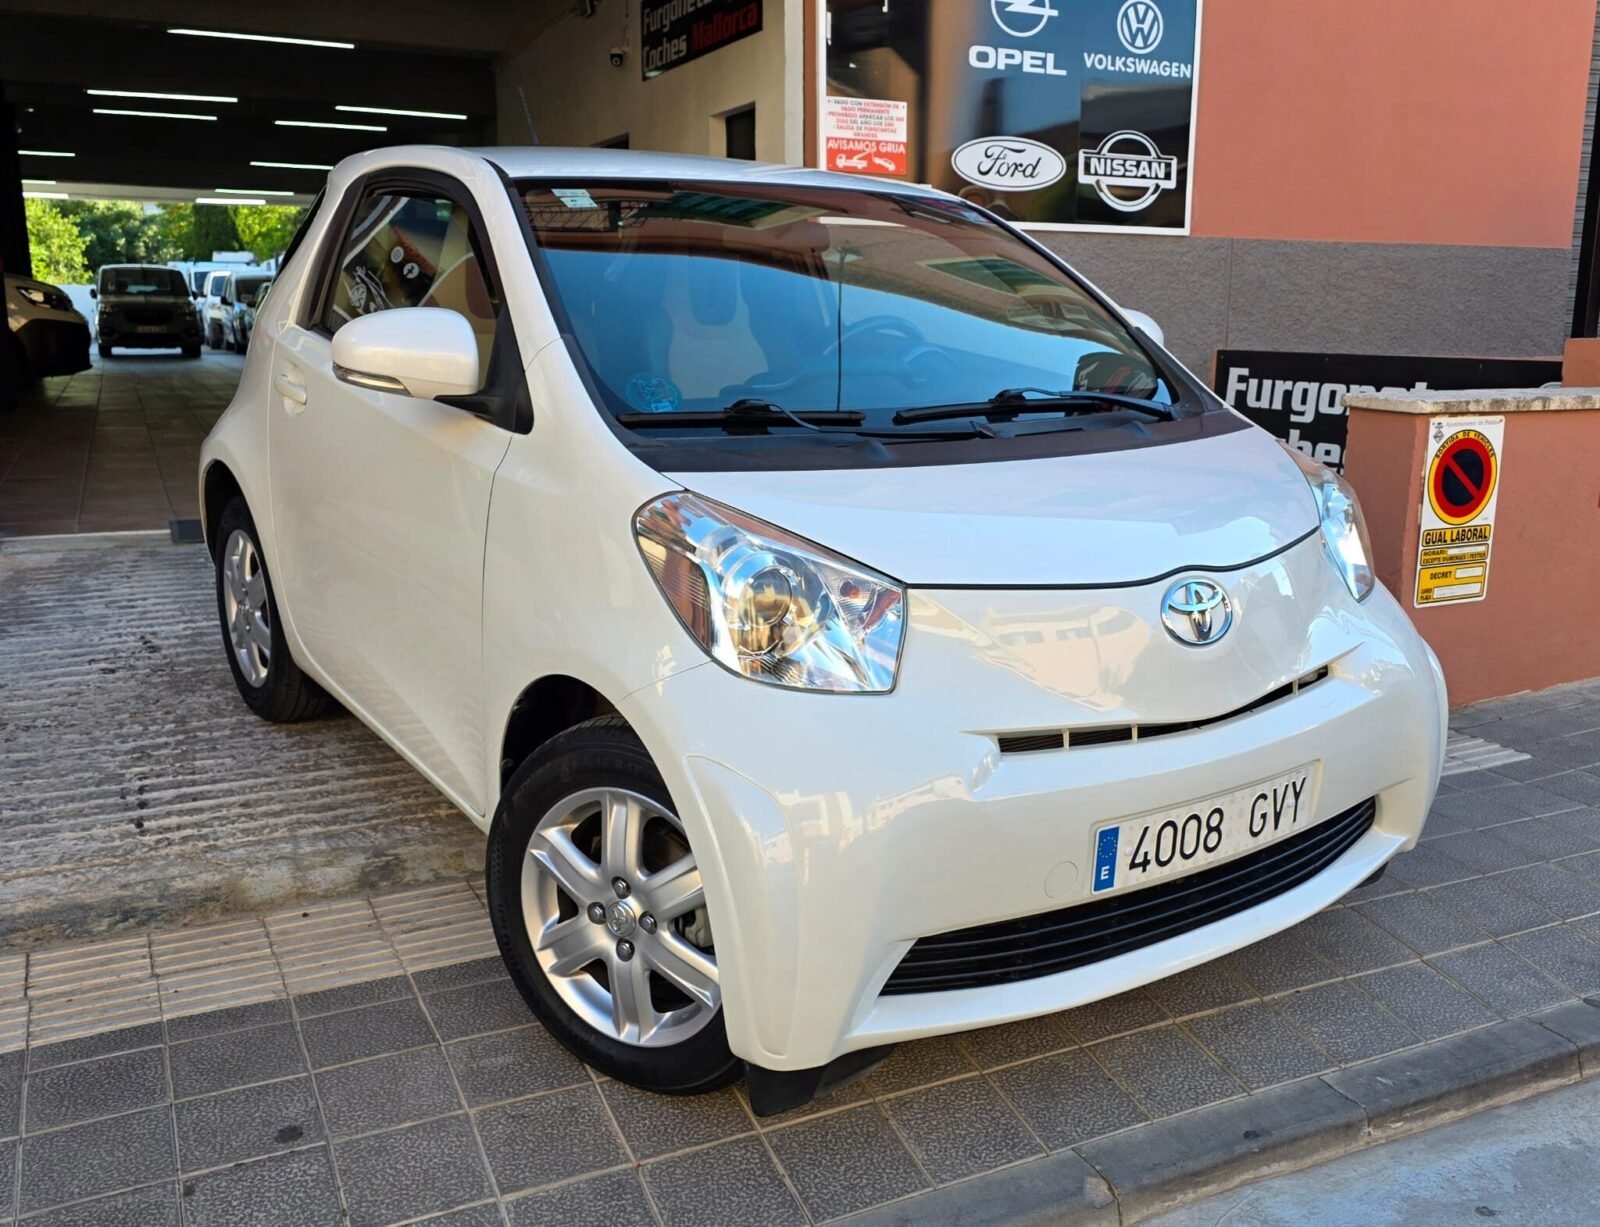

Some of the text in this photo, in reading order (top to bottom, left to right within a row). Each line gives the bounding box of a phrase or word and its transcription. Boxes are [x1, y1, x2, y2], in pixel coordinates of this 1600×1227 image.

[643, 3, 758, 71] Coches Mallorca
[968, 45, 1067, 76] OPEL
[1083, 52, 1192, 79] VOLKSWAGEN
[827, 139, 906, 154] AVISAMOS GRUA
[977, 144, 1042, 179] Ford
[1089, 157, 1166, 179] NISSAN
[1224, 367, 1428, 424] Furgo
[1425, 527, 1488, 545] GUAL LABORAL
[1430, 571, 1452, 580] DECRET
[1128, 776, 1307, 873] 4008 GVY
[1100, 866, 1109, 880] E
